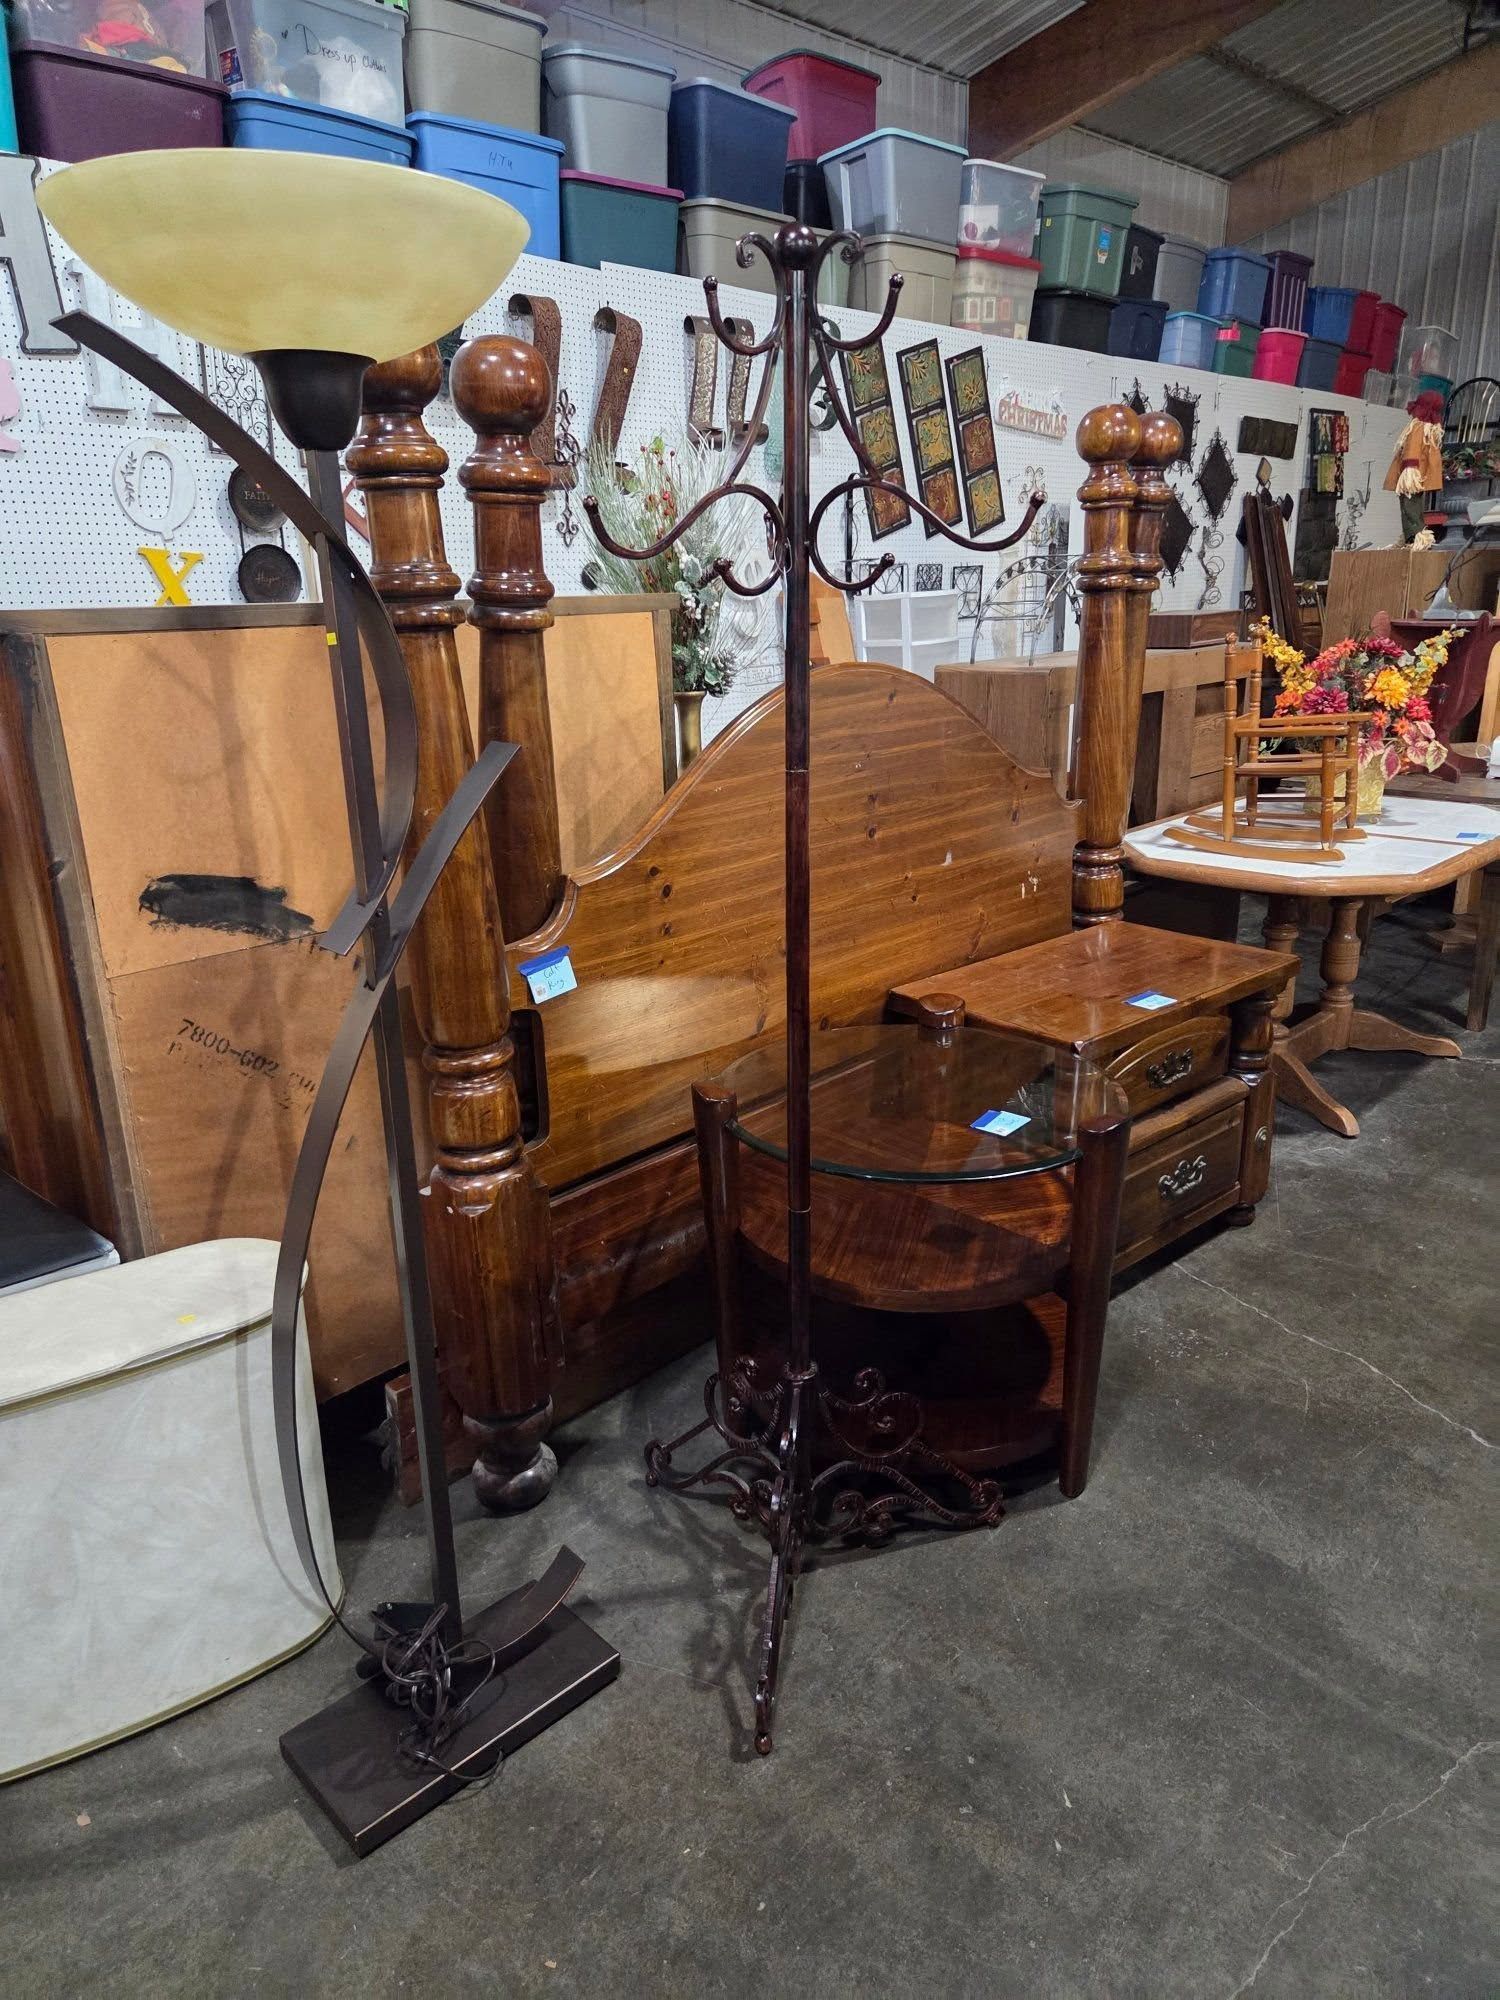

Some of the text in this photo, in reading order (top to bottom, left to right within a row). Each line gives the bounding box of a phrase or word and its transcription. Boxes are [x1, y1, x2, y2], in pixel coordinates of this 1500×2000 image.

[295, 24, 341, 62] Dress
[343, 53, 357, 73] up
[112, 436, 197, 541] Q
[138, 546, 205, 607] X
